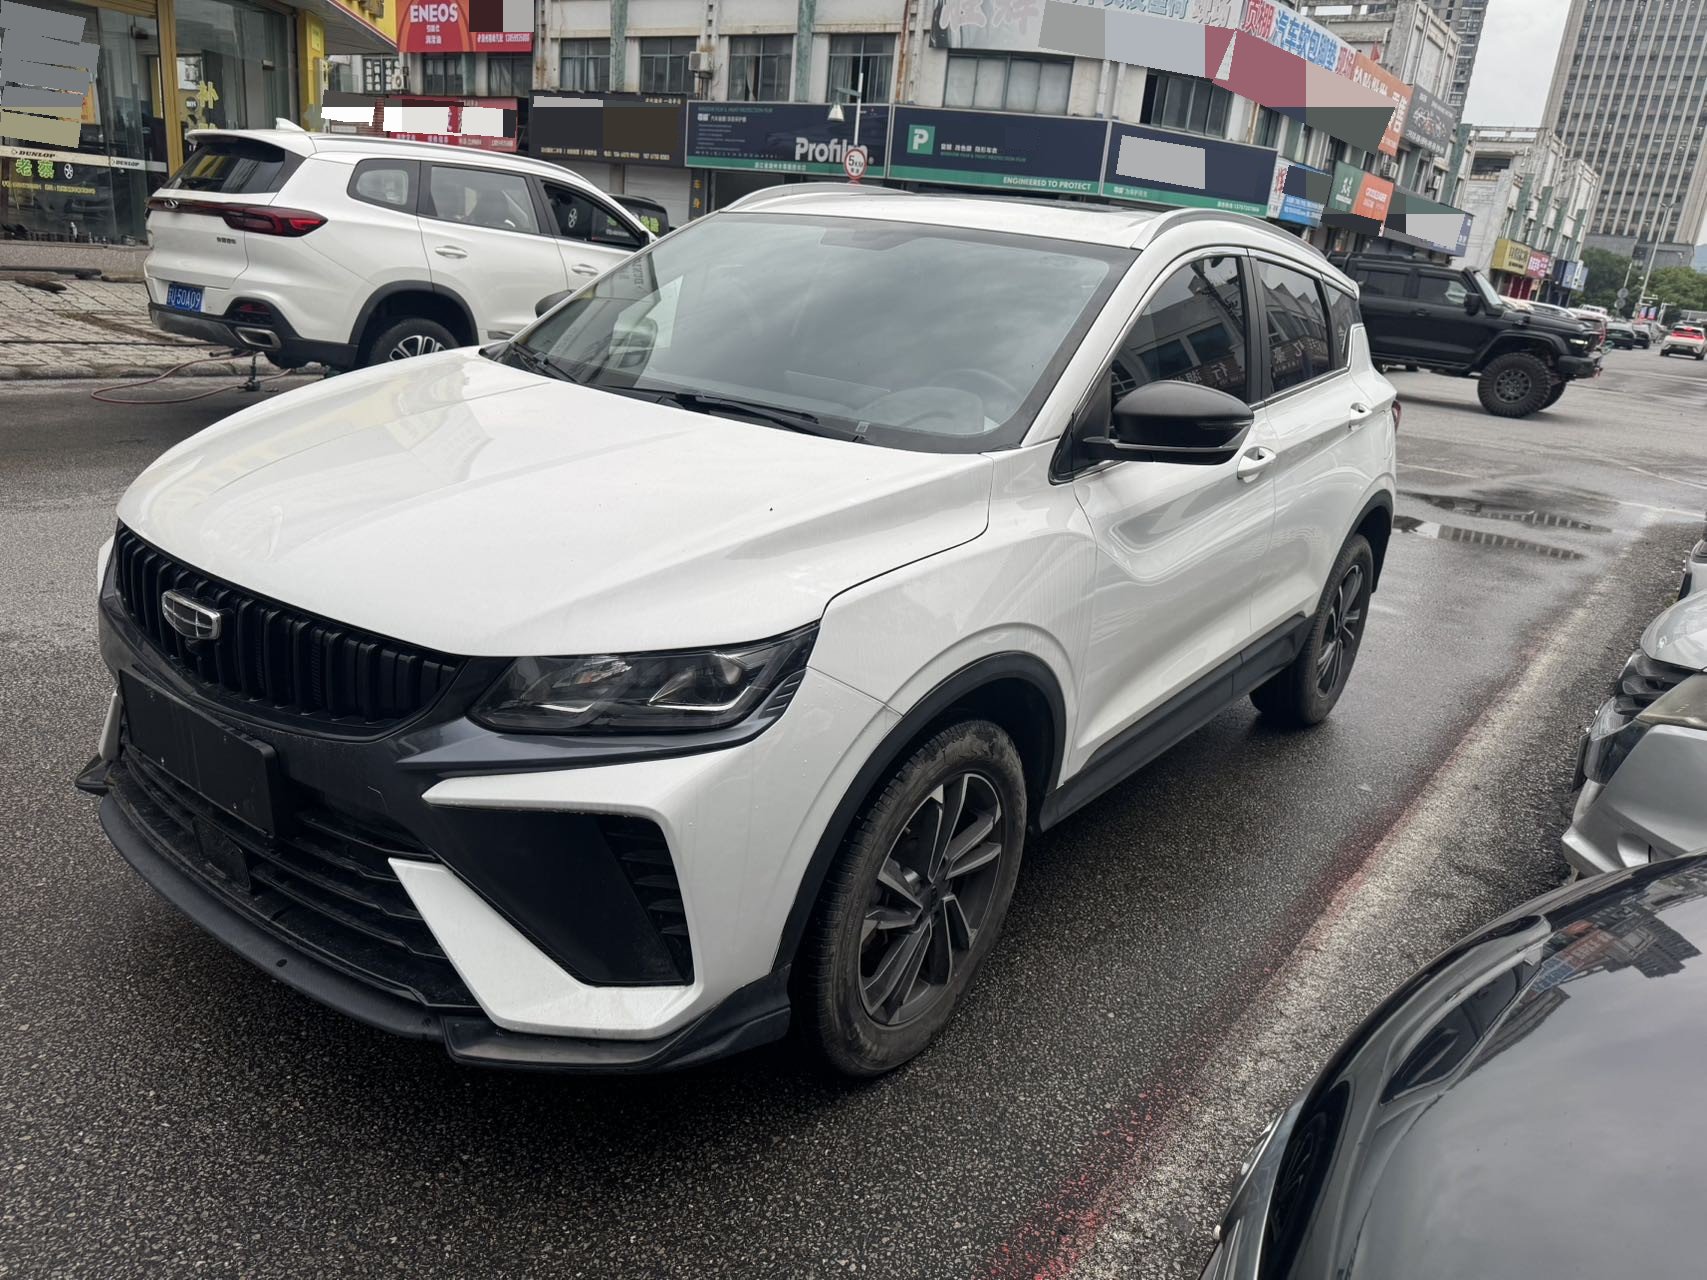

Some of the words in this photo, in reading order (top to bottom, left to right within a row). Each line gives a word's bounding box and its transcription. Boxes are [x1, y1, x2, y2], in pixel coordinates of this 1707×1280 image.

[410, 3, 458, 23] ENEOS
[18, 150, 56, 158] DUNLOP
[1003, 176, 1047, 188] ENGINEERED
[1048, 180, 1058, 189] TO
[1059, 181, 1092, 191] PROTECT
